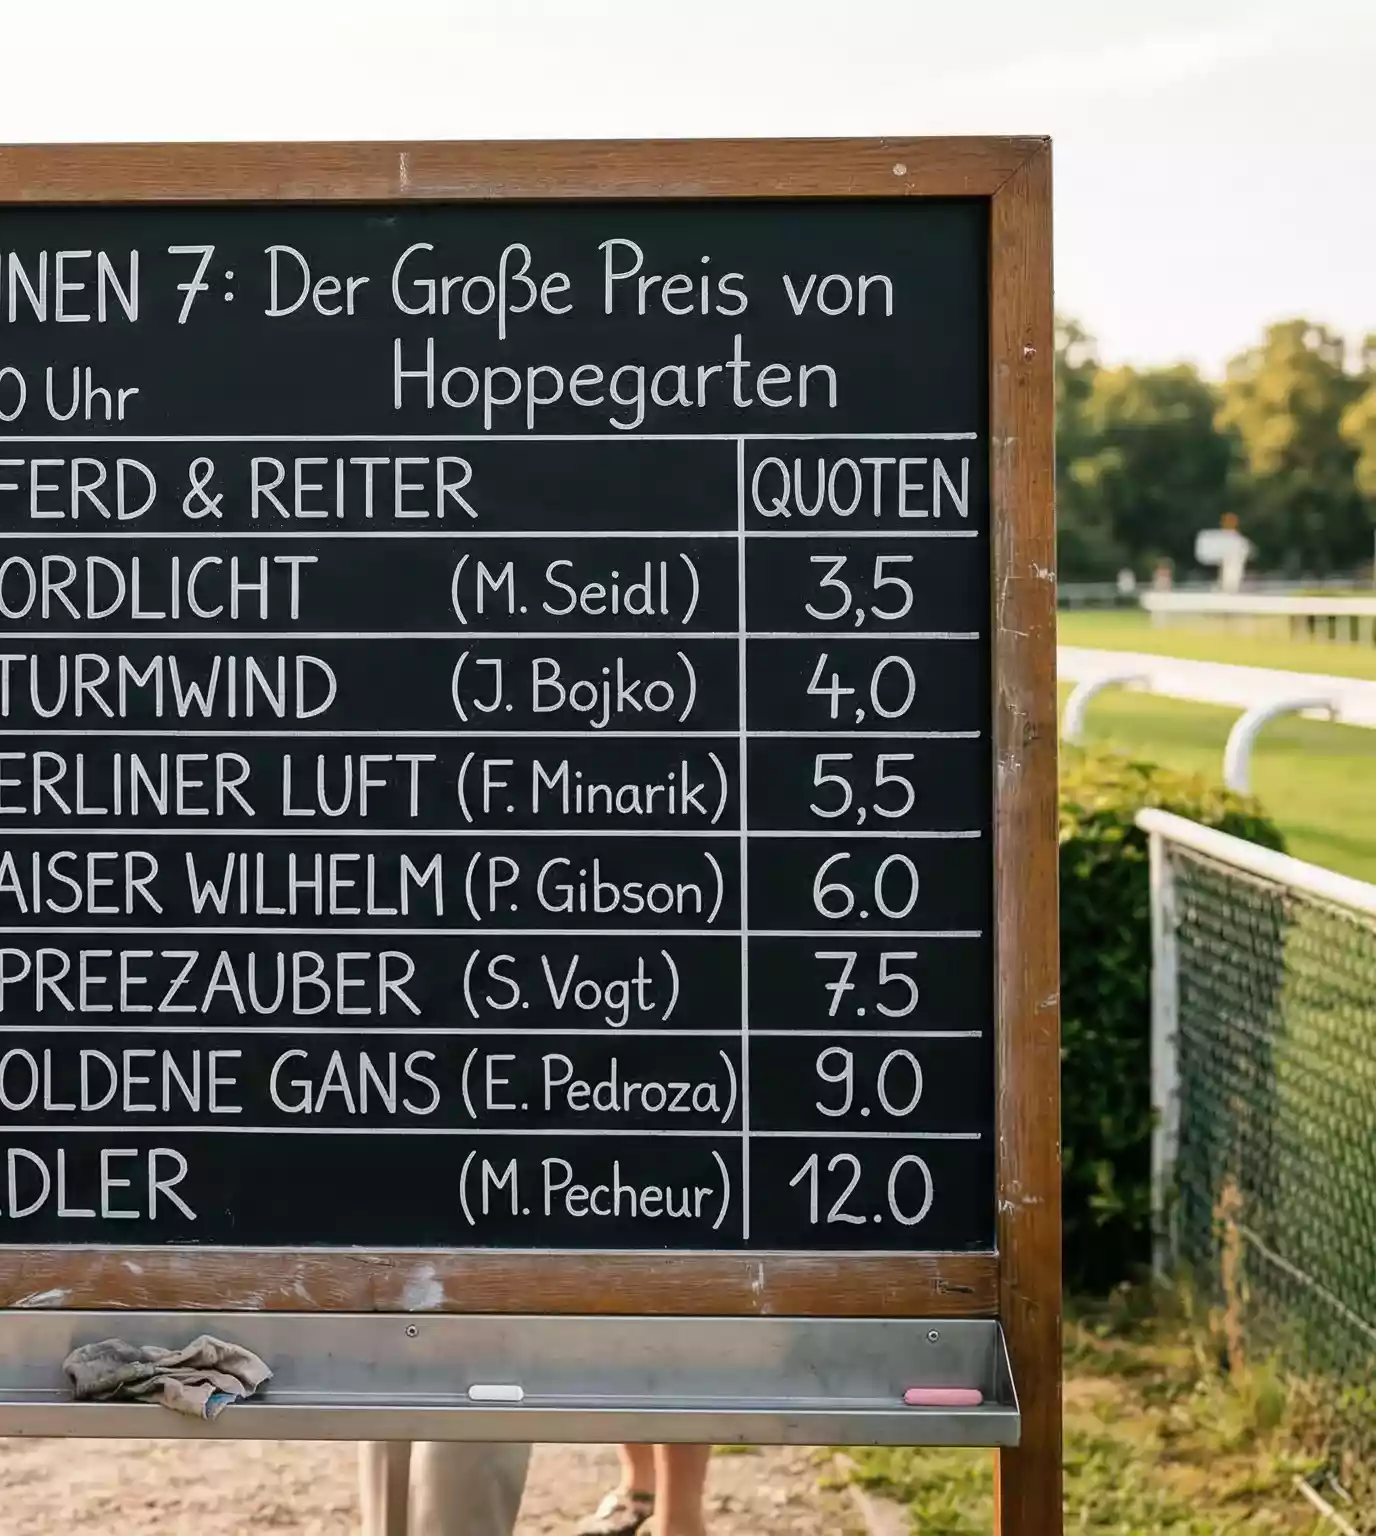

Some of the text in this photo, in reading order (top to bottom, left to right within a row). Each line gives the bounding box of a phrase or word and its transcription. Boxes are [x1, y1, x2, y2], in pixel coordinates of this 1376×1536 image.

[167, 244, 234, 325] 7:
[264, 244, 371, 317] Der
[391, 242, 574, 341] Große
[597, 238, 749, 317] Preis
[782, 273, 893, 317] von
[45, 366, 140, 422] Uhr
[394, 333, 837, 431] Hoppegarten
[182, 456, 224, 519] &
[250, 455, 479, 519] REITER
[751, 456, 970, 518] QUOTEN
[451, 553, 528, 625] (M.
[542, 552, 700, 625] Seidl)
[804, 554, 914, 628] 3,5
[451, 650, 514, 723] (J.
[531, 651, 697, 729] Bojko)
[806, 652, 916, 724] 4,0
[282, 753, 437, 818] LUFT
[457, 751, 515, 823] (F.
[532, 751, 728, 825] Minarik)
[809, 752, 916, 826] 5,5
[185, 851, 444, 917] WILHELM
[465, 851, 520, 922] (P.
[536, 851, 724, 924] Gibson)
[812, 851, 919, 919] 6.0
[463, 948, 530, 1019] (S.
[540, 949, 680, 1028] Vogt)
[814, 951, 919, 1018] 7.5
[269, 1049, 441, 1115] GANS
[461, 1047, 528, 1120] (E.
[541, 1049, 737, 1124] Pedroza)
[815, 1046, 923, 1117] 9.0
[459, 1150, 531, 1226] (M.
[541, 1150, 730, 1230] Pecheur)
[788, 1153, 934, 1226] 12.0
